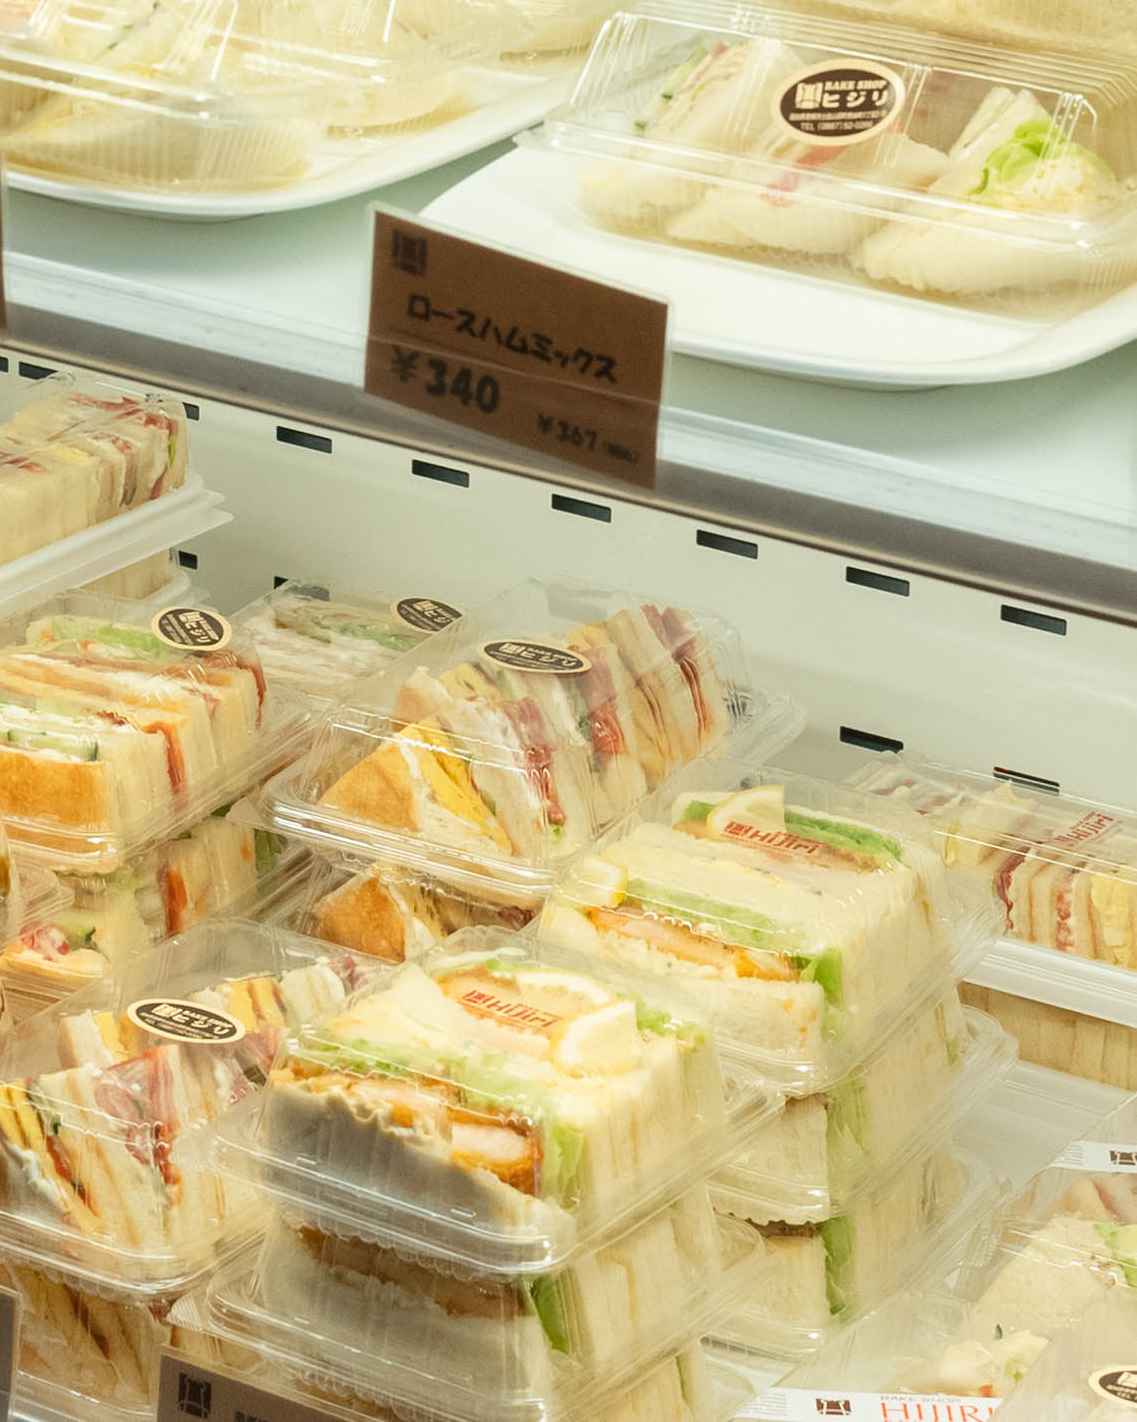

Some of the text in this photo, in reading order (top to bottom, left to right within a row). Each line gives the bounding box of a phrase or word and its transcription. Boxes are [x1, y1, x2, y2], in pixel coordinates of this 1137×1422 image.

[822, 90, 889, 108] ヒジリ
[407, 293, 617, 384] ロースハムミックス
[390, 344, 500, 413] ¥340
